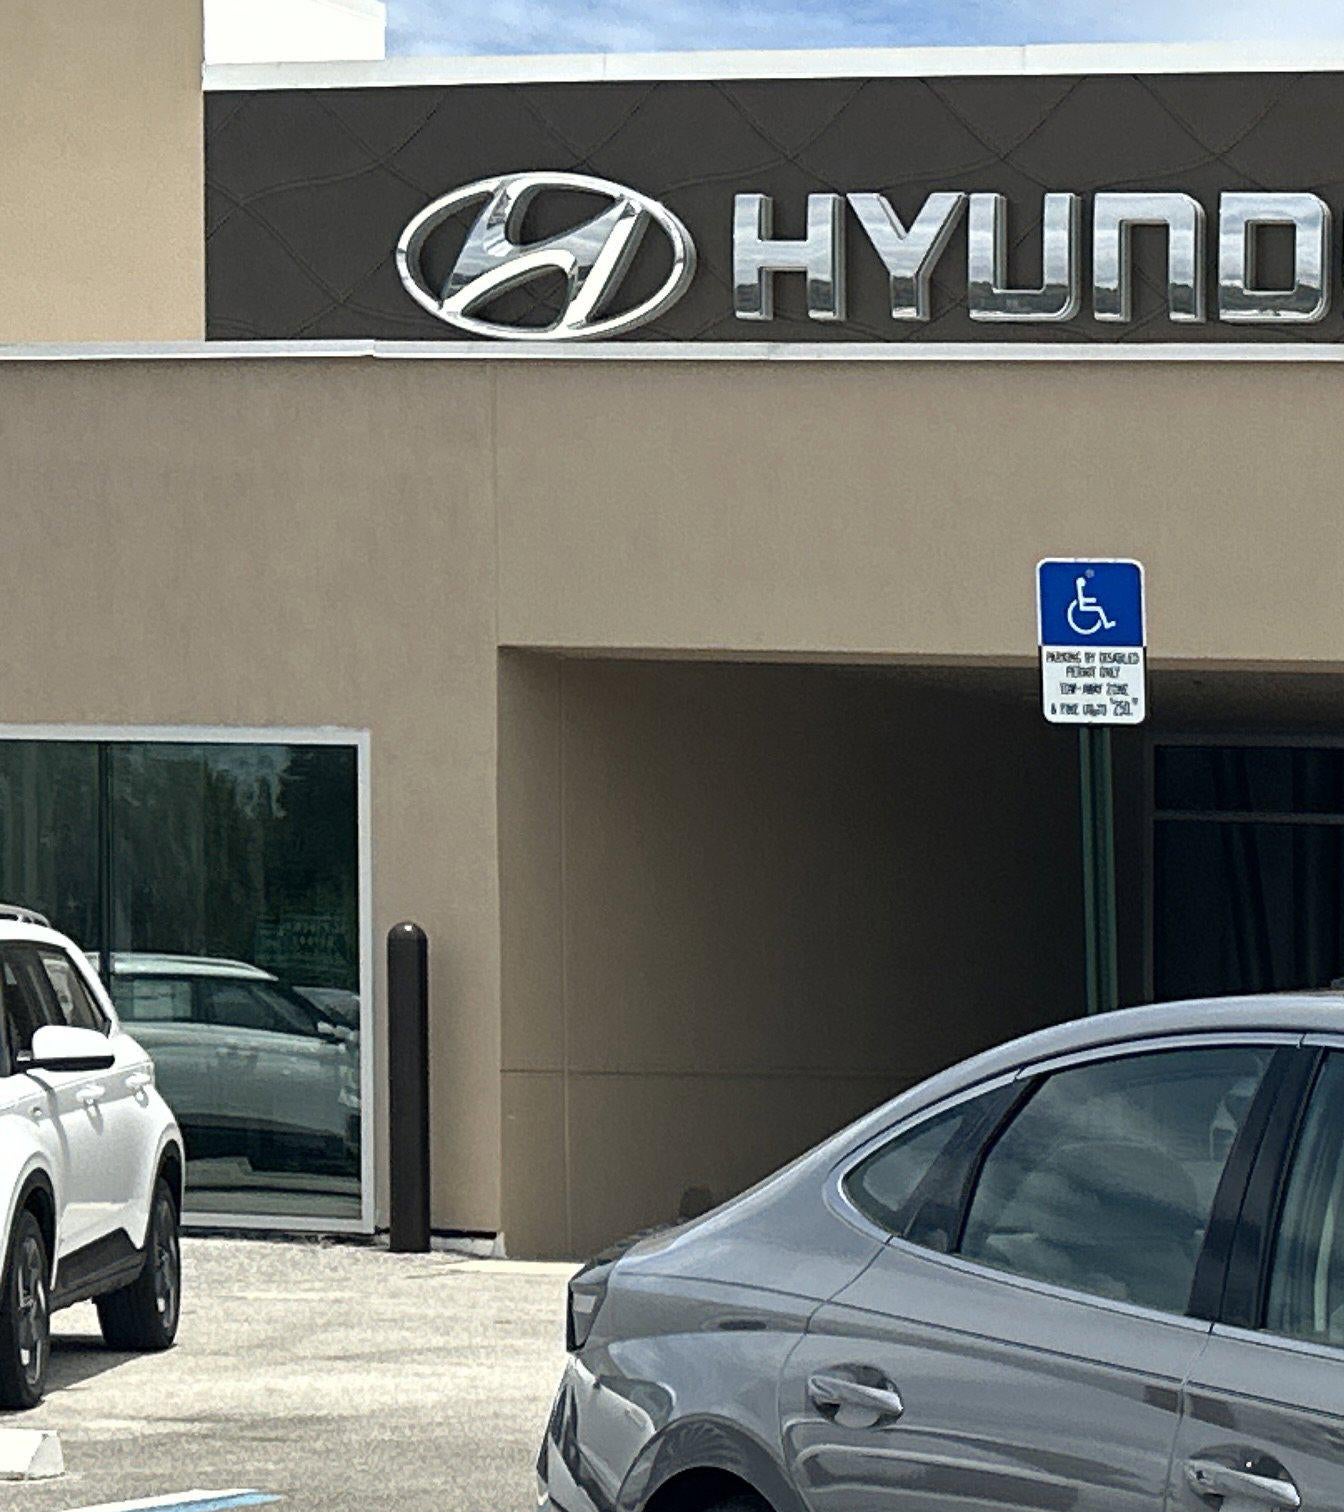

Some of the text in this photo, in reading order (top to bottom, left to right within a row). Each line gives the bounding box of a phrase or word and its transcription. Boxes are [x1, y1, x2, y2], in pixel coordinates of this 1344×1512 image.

[1046, 651, 1082, 663] PARKING
[1099, 652, 1140, 664] DISABLED
[1099, 666, 1120, 678] ONLY
